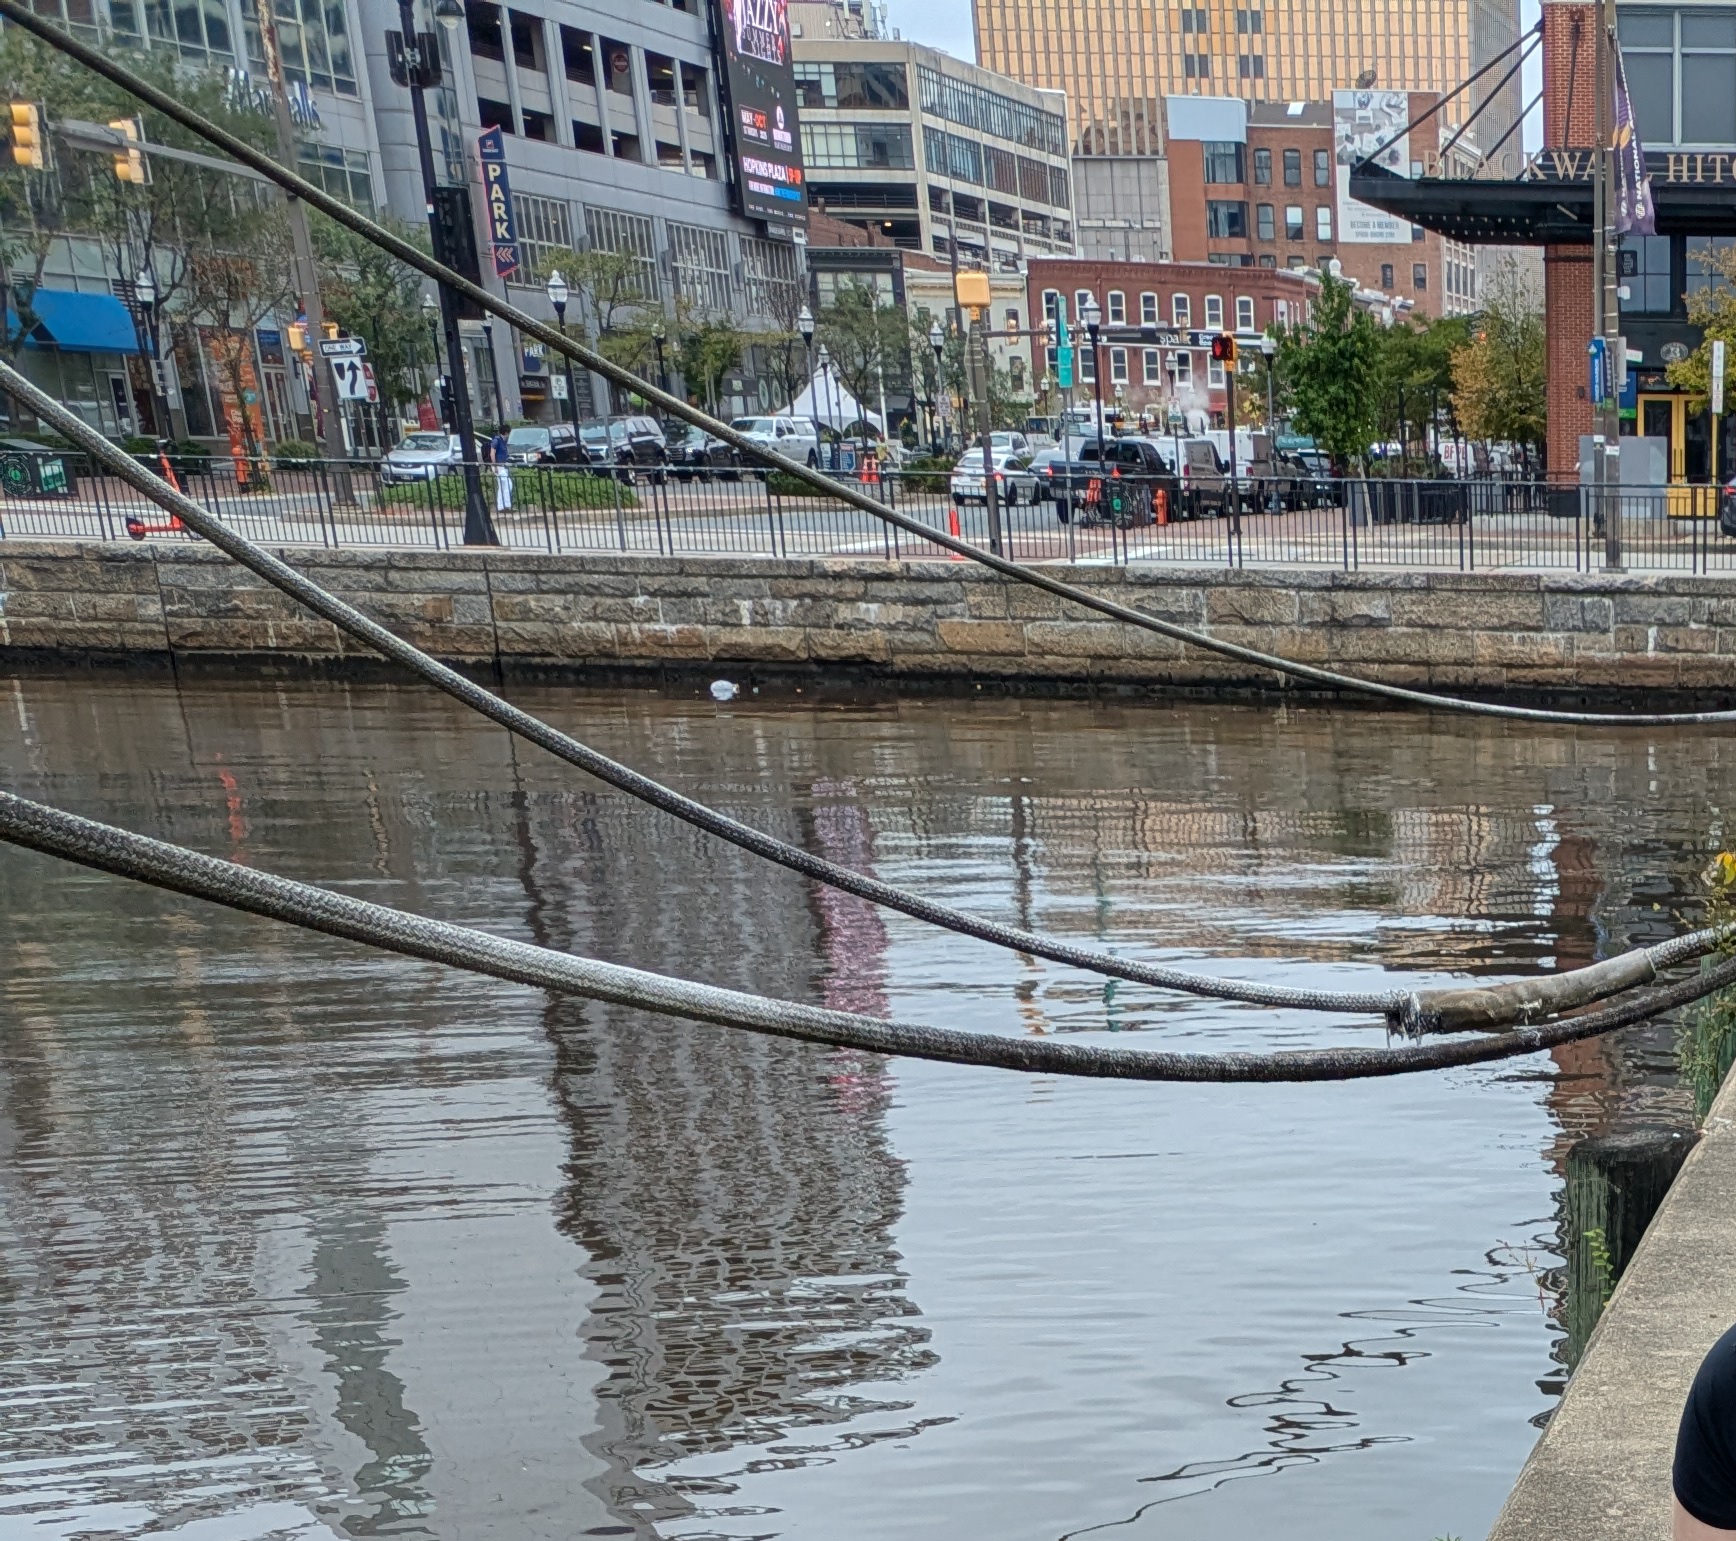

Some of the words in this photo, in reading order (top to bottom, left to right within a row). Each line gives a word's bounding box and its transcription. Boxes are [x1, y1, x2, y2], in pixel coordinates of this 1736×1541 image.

[1422, 151, 1653, 183] BLACKWA
[1631, 131, 1643, 200] NATIONAL
[487, 163, 512, 240] PARK
